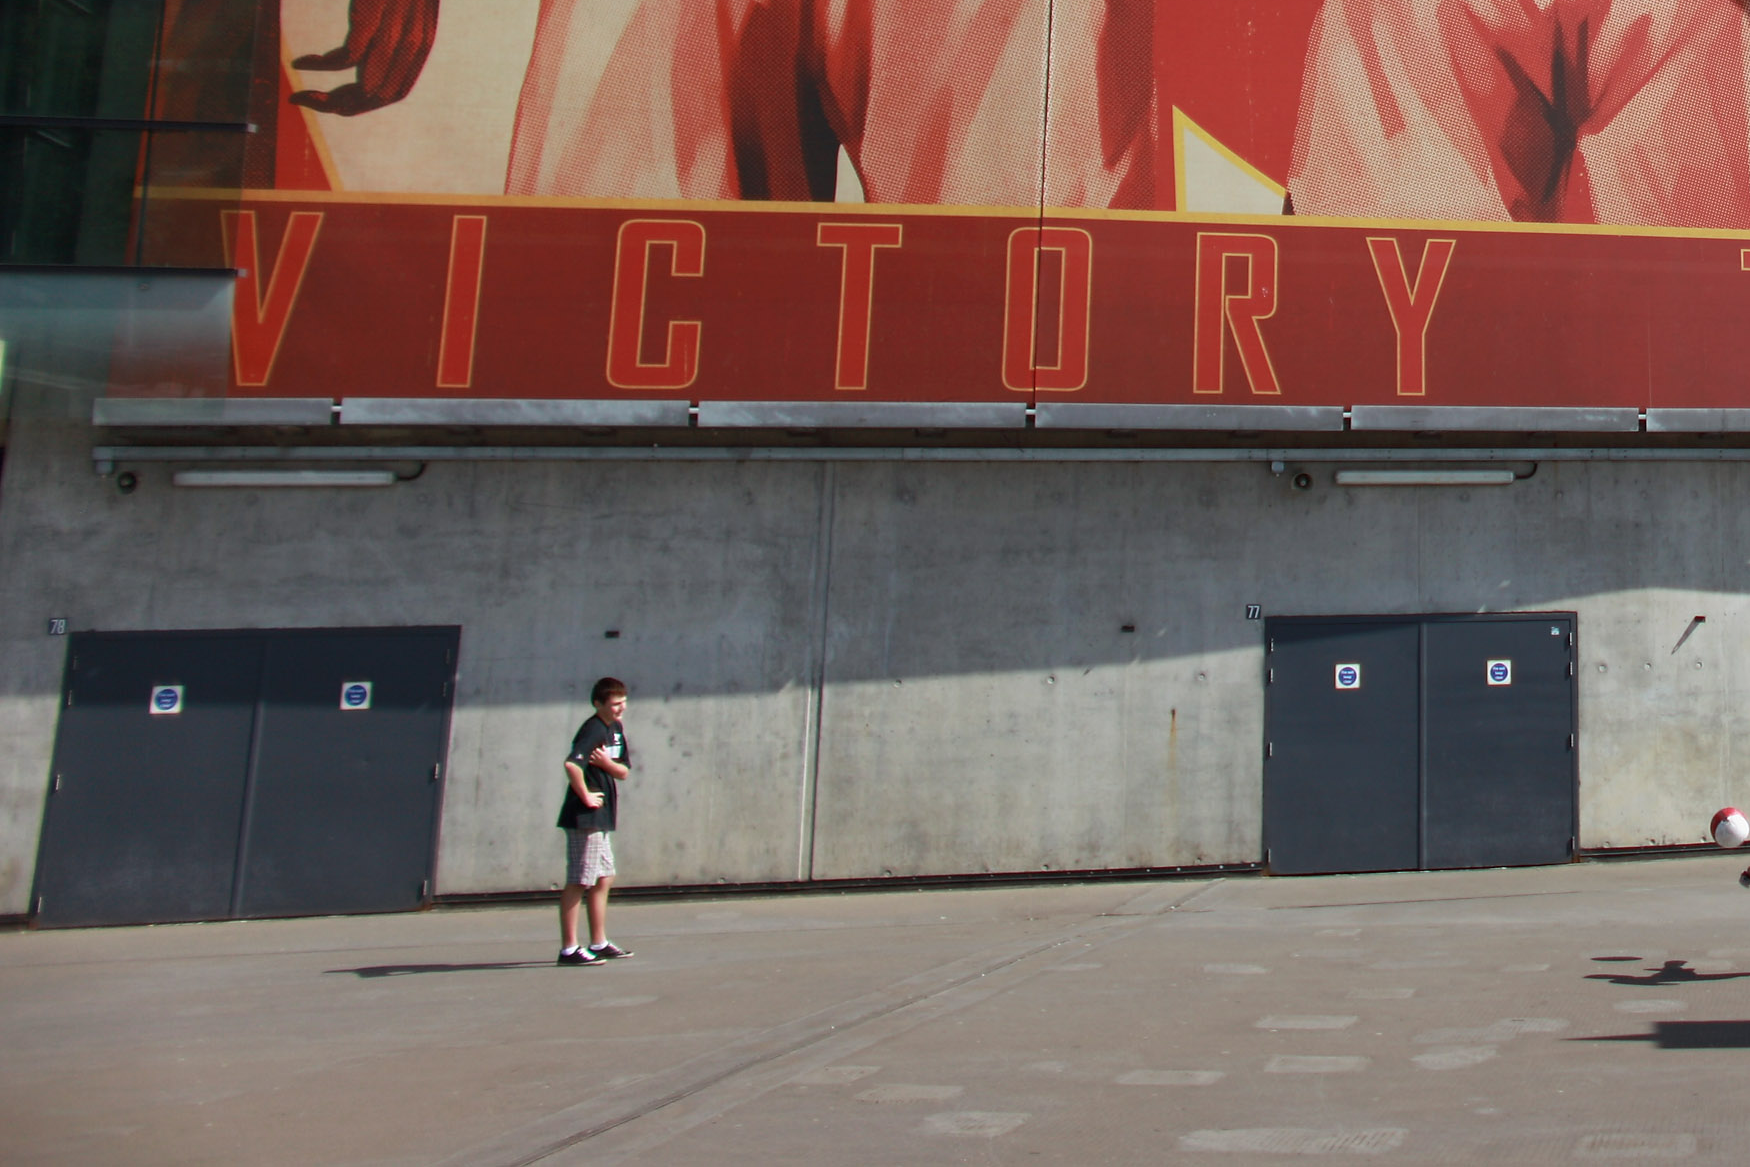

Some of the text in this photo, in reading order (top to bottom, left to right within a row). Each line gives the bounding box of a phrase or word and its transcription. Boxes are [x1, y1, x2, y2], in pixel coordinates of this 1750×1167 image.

[219, 209, 1457, 397] VICTORY
[1247, 605, 1260, 619] 77
[50, 619, 65, 634] 78
